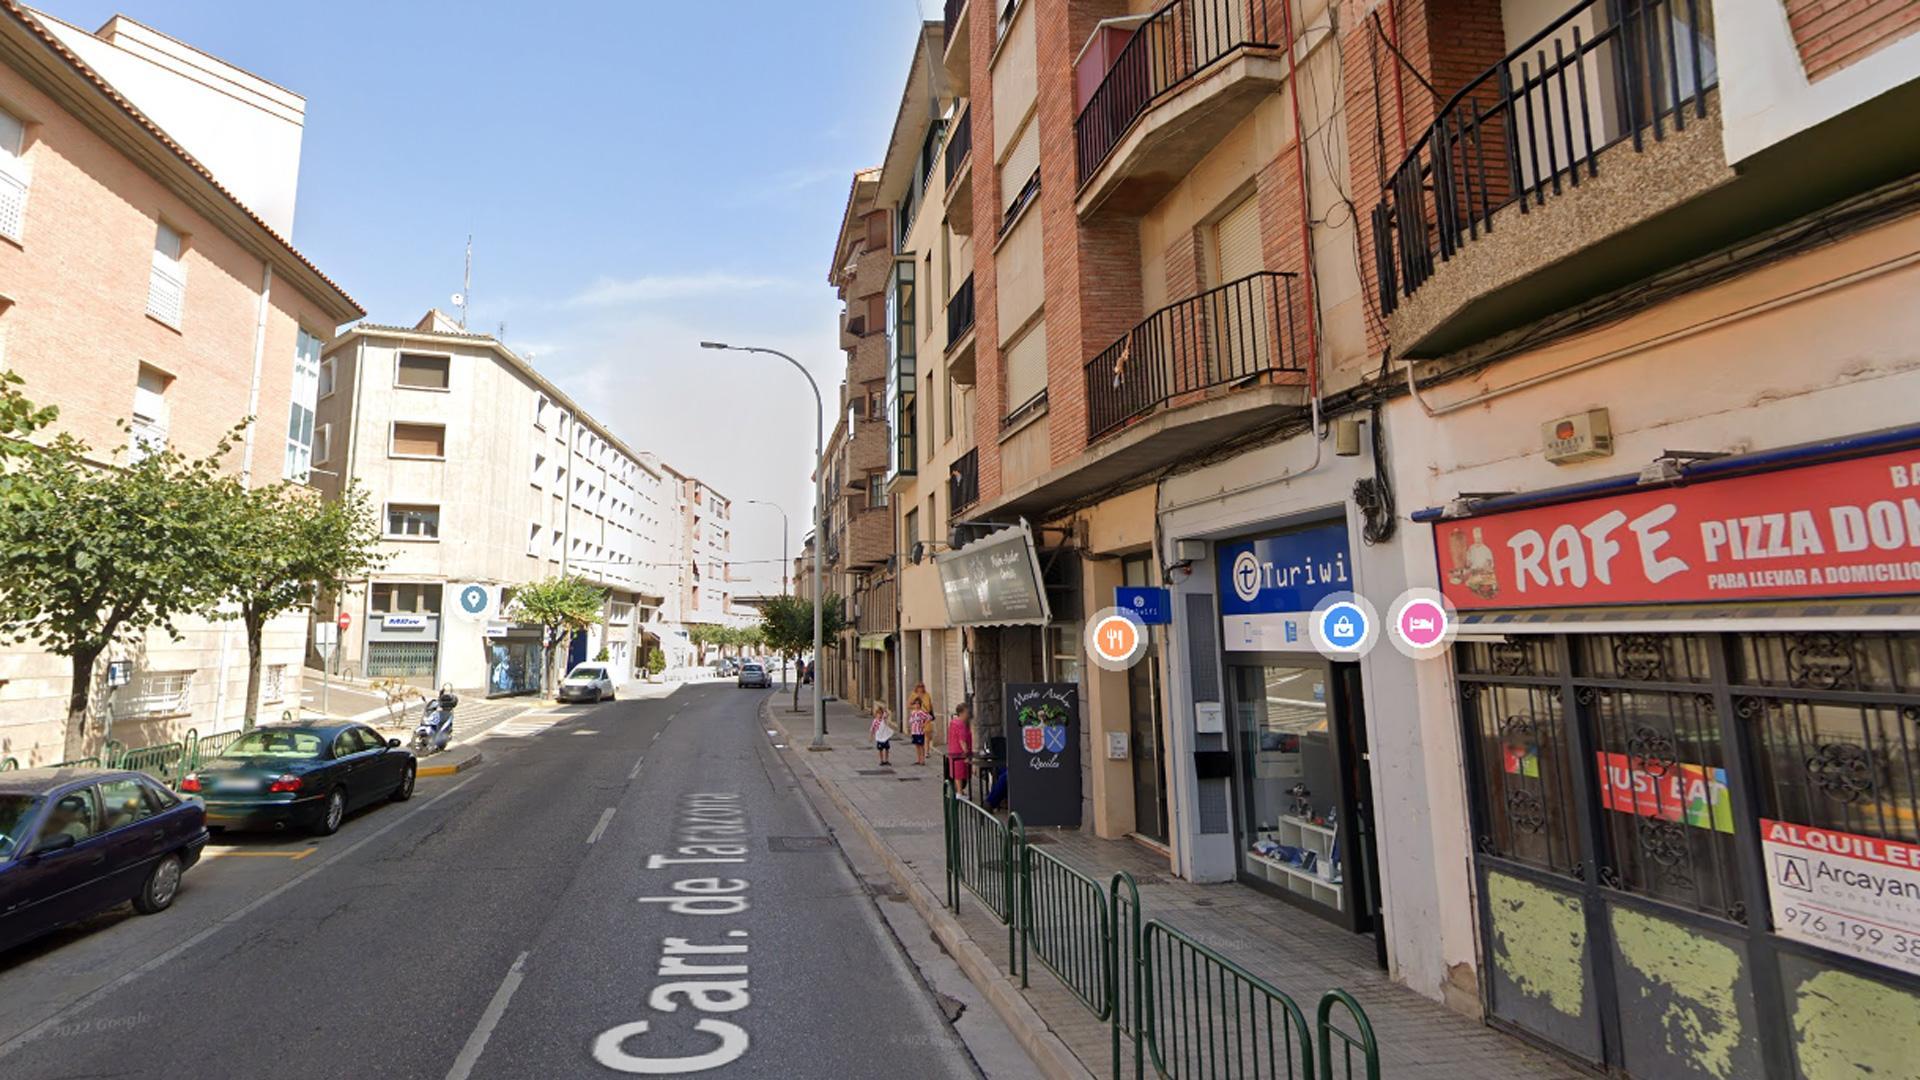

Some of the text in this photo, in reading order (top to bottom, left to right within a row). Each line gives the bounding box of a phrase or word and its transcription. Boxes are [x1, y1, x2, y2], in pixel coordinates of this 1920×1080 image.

[1507, 503, 1689, 593] RAFE
[1700, 510, 1825, 562] PIZZA
[1262, 552, 1348, 589] Turiwi
[1707, 573, 1748, 590] PARA
[1749, 568, 1808, 588] LLEVAR
[1810, 567, 1824, 585] A
[1603, 765, 1727, 806] JUST EAT
[1784, 906, 1828, 932] 976
[1838, 921, 1884, 945] 199
